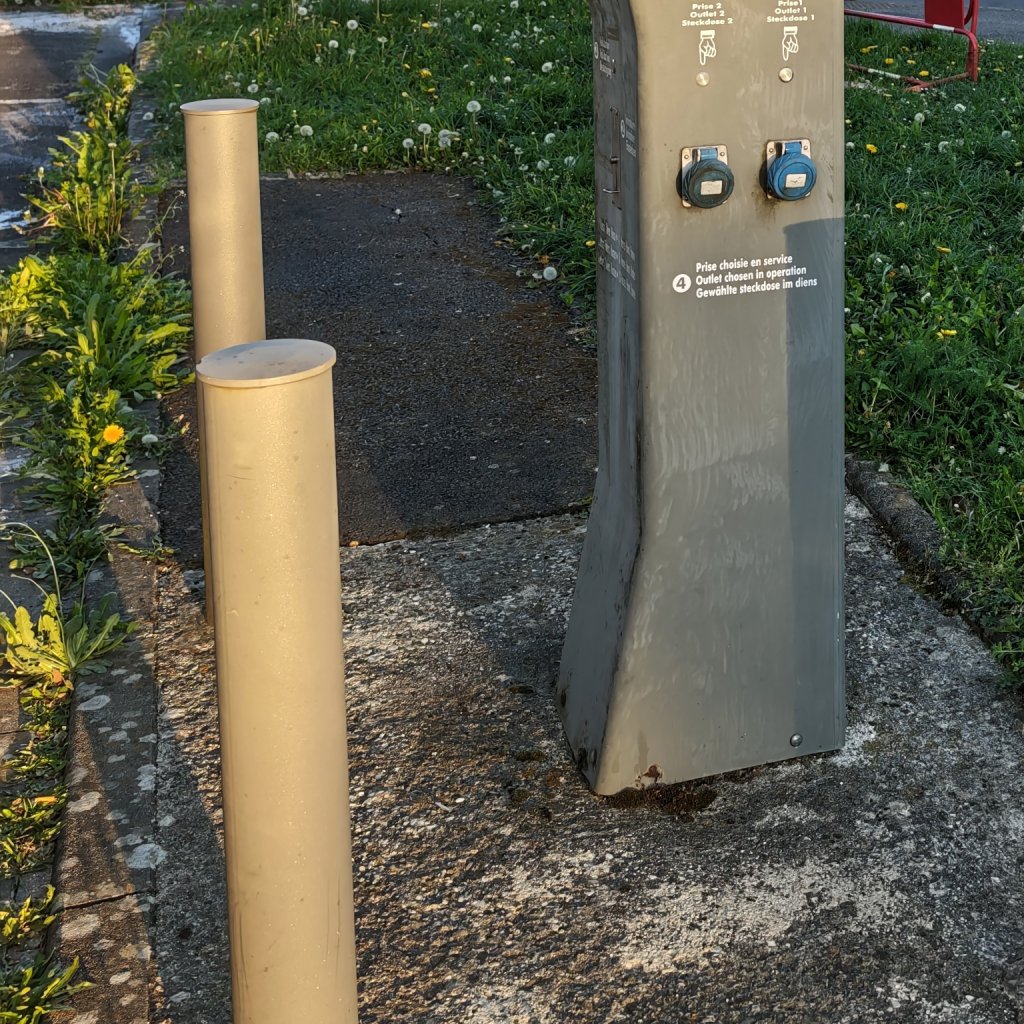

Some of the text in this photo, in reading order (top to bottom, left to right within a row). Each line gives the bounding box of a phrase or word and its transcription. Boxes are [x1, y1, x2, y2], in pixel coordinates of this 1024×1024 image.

[690, 11, 717, 19] Outlet
[774, 7, 801, 15] Outlet
[681, 17, 734, 27] Steckdose 2
[766, 15, 809, 23] Steckdose
[696, 254, 793, 273] Prise choisie en service
[695, 274, 723, 286] Outlet
[724, 271, 754, 283] chosen
[756, 269, 764, 279] in
[766, 265, 807, 280] operation
[695, 277, 818, 298] Gewählte steckdose im diens
